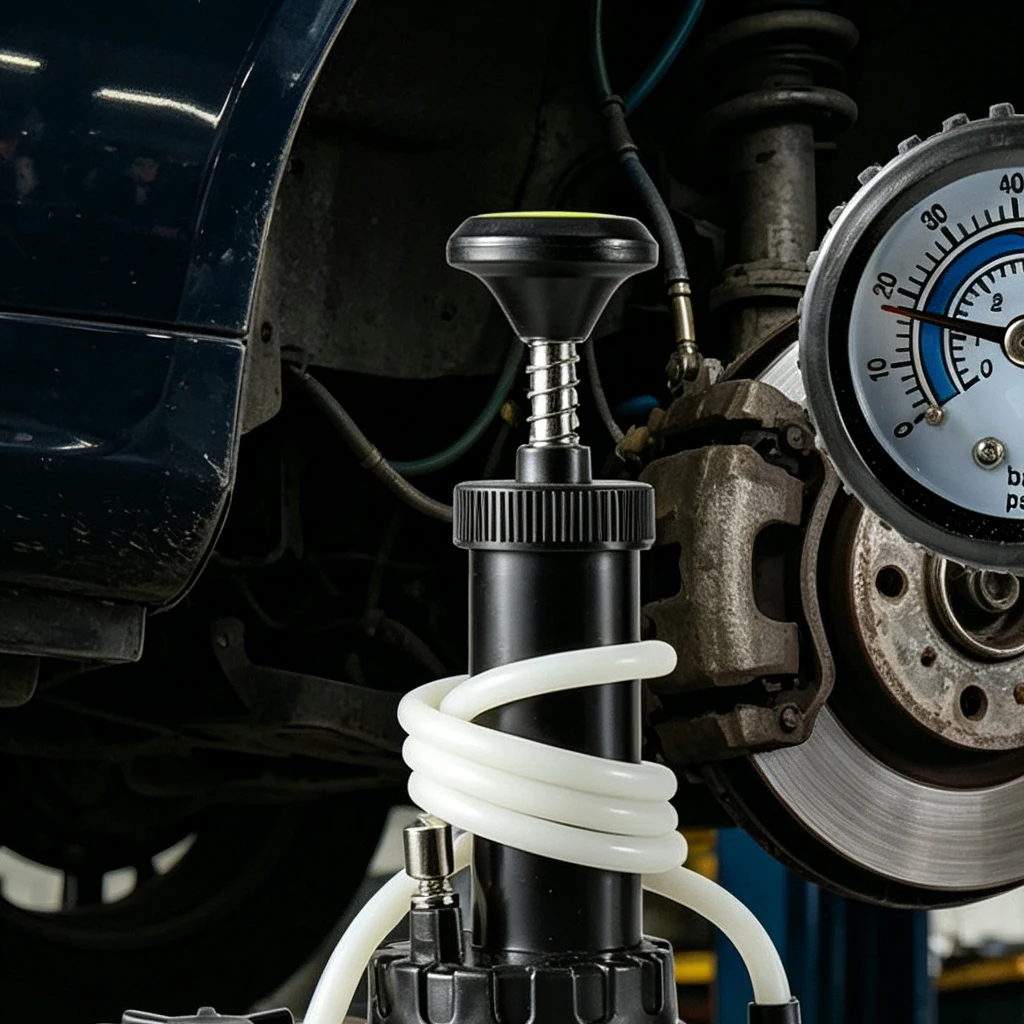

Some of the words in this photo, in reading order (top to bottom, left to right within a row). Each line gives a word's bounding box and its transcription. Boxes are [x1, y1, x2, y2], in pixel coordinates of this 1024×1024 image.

[999, 173, 1024, 194] 40
[920, 203, 948, 231] 30
[872, 272, 898, 300] 20
[867, 358, 889, 381] 10
[980, 358, 993, 379] 0
